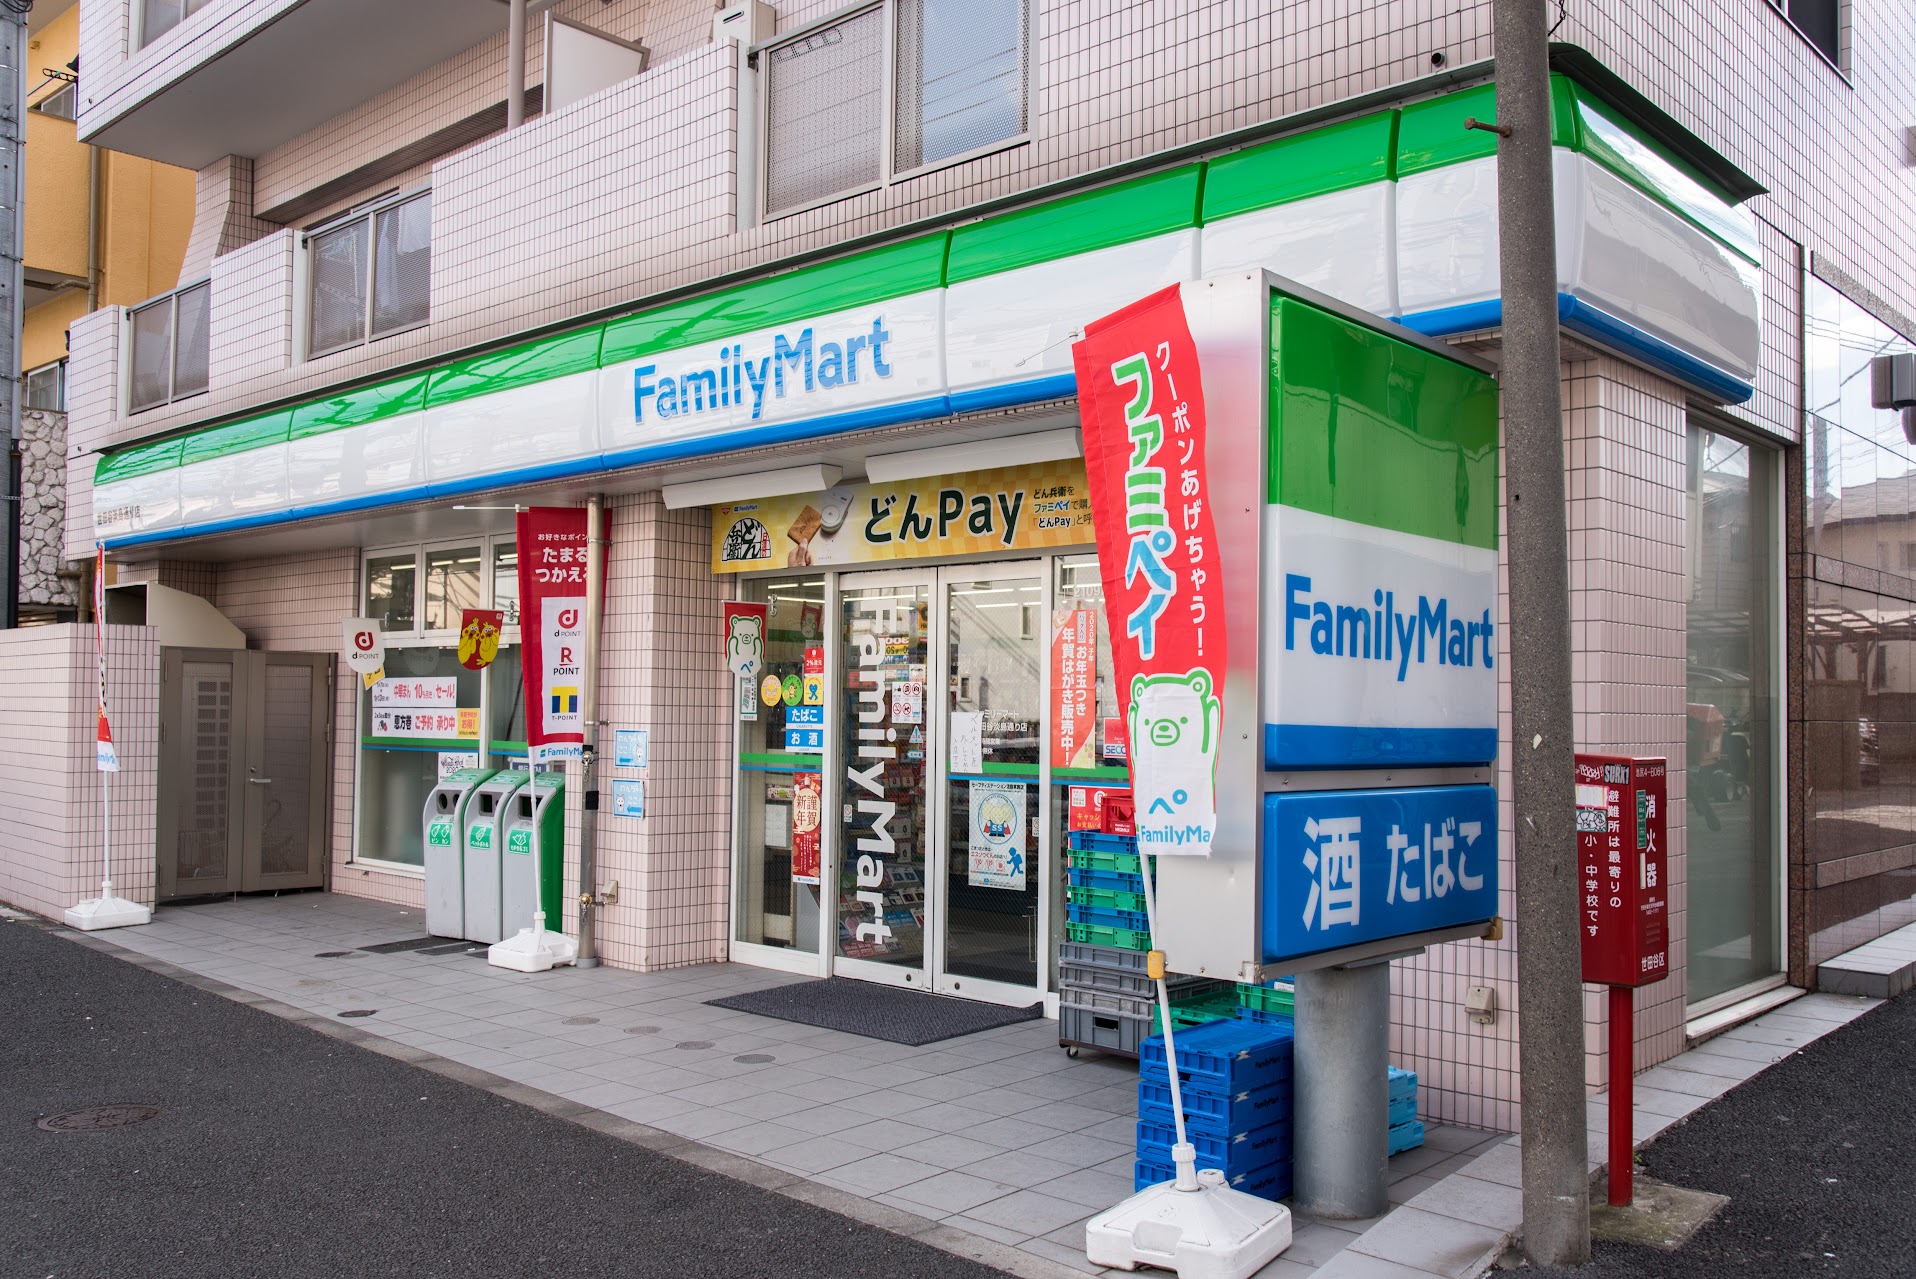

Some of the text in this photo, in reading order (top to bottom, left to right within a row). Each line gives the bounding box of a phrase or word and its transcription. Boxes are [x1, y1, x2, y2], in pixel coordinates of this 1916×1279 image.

[634, 314, 892, 425] FamilyMart
[864, 488, 1025, 546] どんPay
[1033, 486, 1075, 499] どん兵衛を
[1112, 352, 1177, 660] ファミペイ
[1156, 340, 1206, 656] クーポンあげちゃう!
[542, 547, 587, 563] たまる
[553, 667, 580, 676] POINT
[1286, 572, 1494, 682] FamilyMart
[394, 715, 412, 730] 恵方巻
[415, 715, 433, 731] ご予約
[791, 708, 818, 722] たばこ
[1060, 627, 1075, 766] 年賀はがき販売中!
[1075, 646, 1087, 717] お年玉つき
[847, 599, 898, 945] FamilyMart
[1149, 788, 1188, 815] ペ
[1302, 815, 1484, 932] 酒 たばこ
[1584, 834, 1599, 938] 小・中学校です
[1607, 789, 1622, 909] 避難所は最寄りの
[1646, 794, 1657, 888] 消火器
[1641, 951, 1665, 972] 世田谷区
